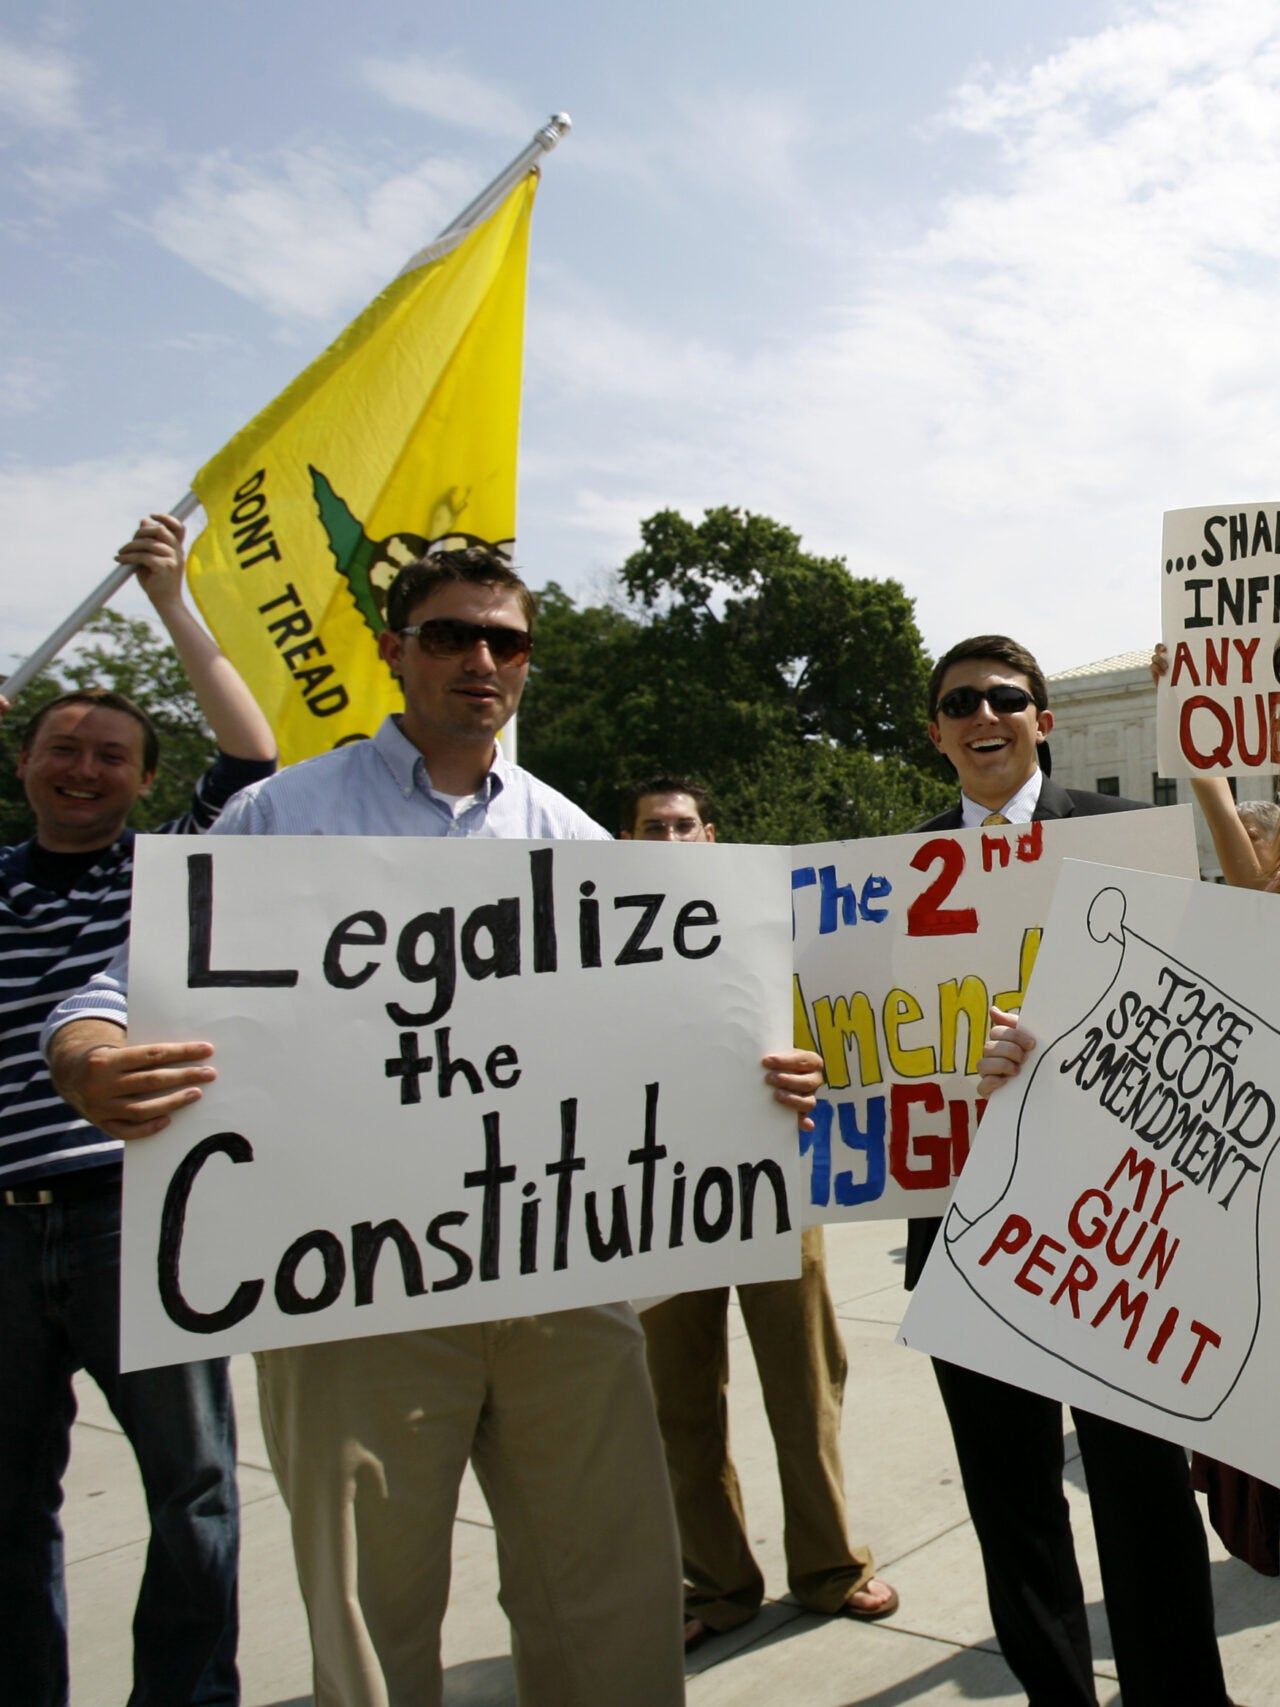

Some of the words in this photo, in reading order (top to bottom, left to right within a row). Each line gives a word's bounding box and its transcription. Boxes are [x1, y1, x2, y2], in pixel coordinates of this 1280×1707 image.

[230, 468, 282, 569] DONT
[258, 584, 349, 718] TREAD
[1170, 637, 1260, 687] ANY
[187, 848, 722, 1027] Legalize
[904, 819, 1044, 937] 2nd
[384, 1027, 522, 1105] the
[1105, 990, 1276, 1149] SECOND
[1158, 966, 1254, 1066] THE
[1060, 1027, 1262, 1211] AMENDMENT
[1103, 1146, 1185, 1226] MY
[156, 1082, 792, 1335] Constitution
[1067, 1188, 1180, 1290] GUN
[978, 1213, 1222, 1385] PERMIT
